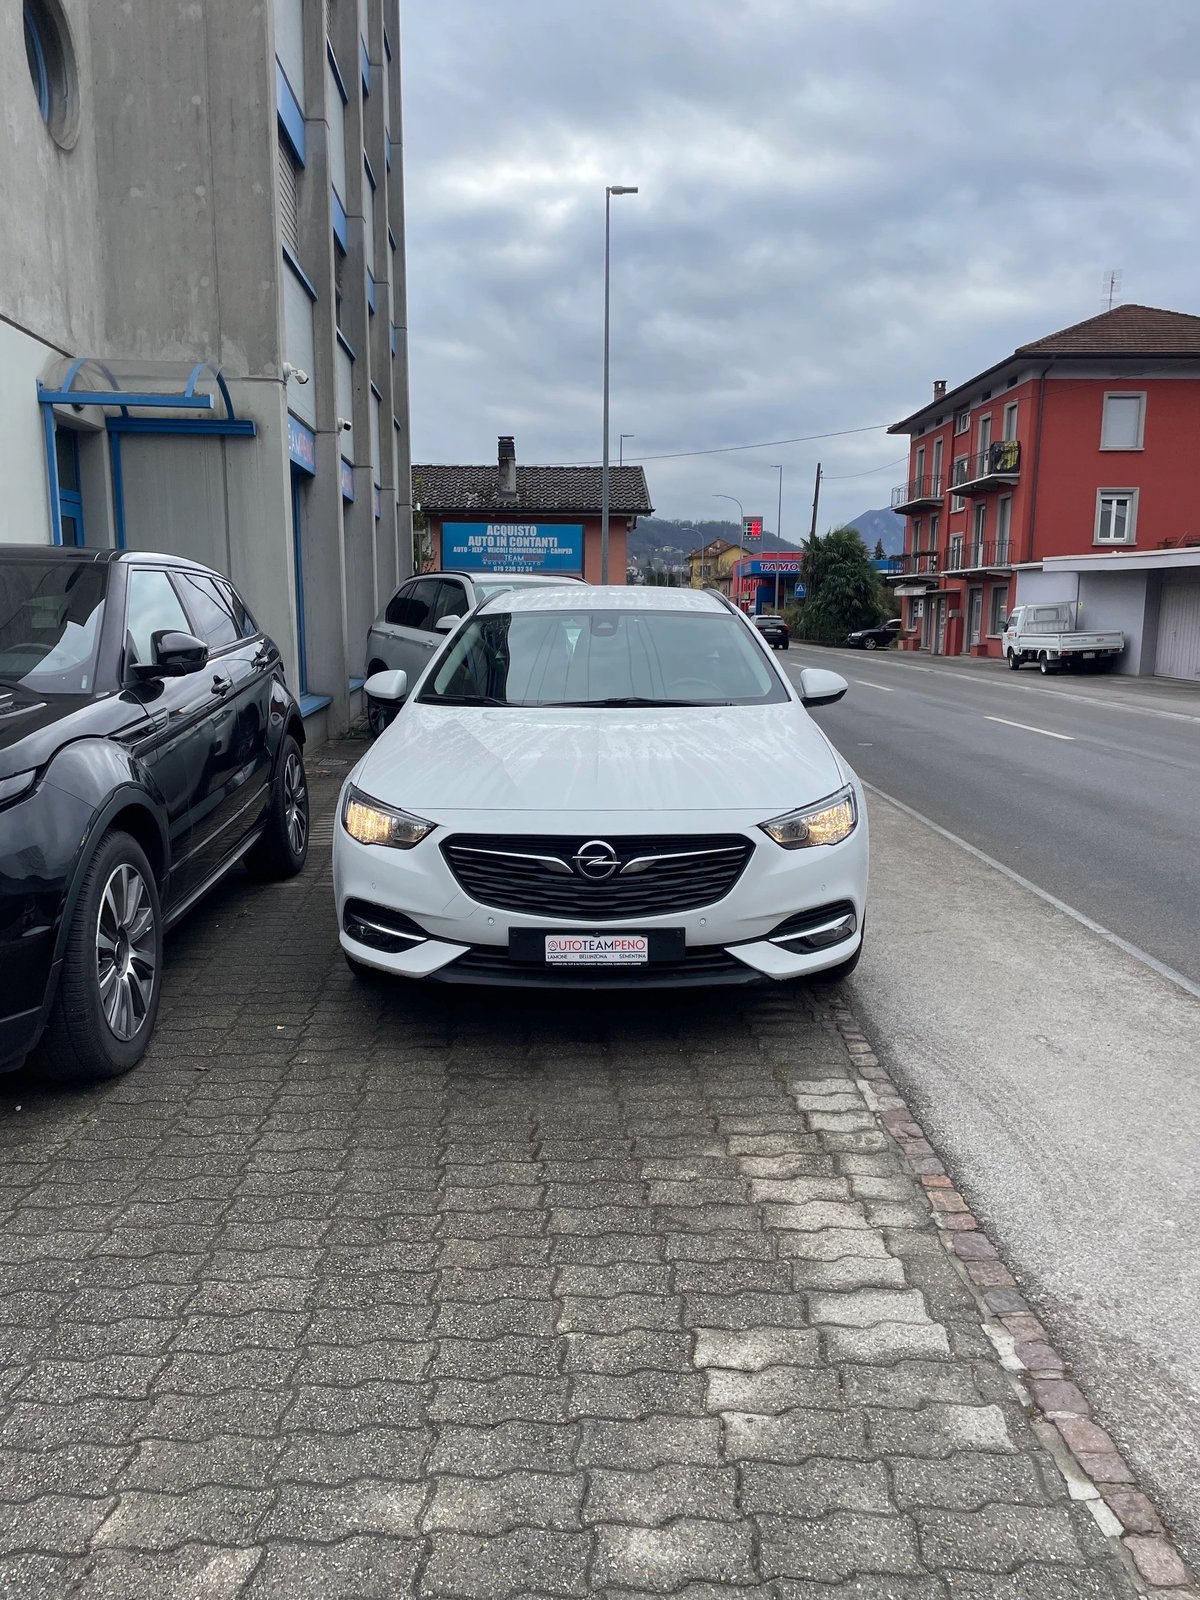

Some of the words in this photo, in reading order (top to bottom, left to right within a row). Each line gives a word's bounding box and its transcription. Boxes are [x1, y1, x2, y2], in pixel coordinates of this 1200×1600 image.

[487, 525, 537, 536] ACQUISTO
[468, 536, 494, 546] AUTO
[497, 536, 507, 547] IN
[509, 537, 558, 547] CONTANTI
[760, 562, 800, 571] TAMO
